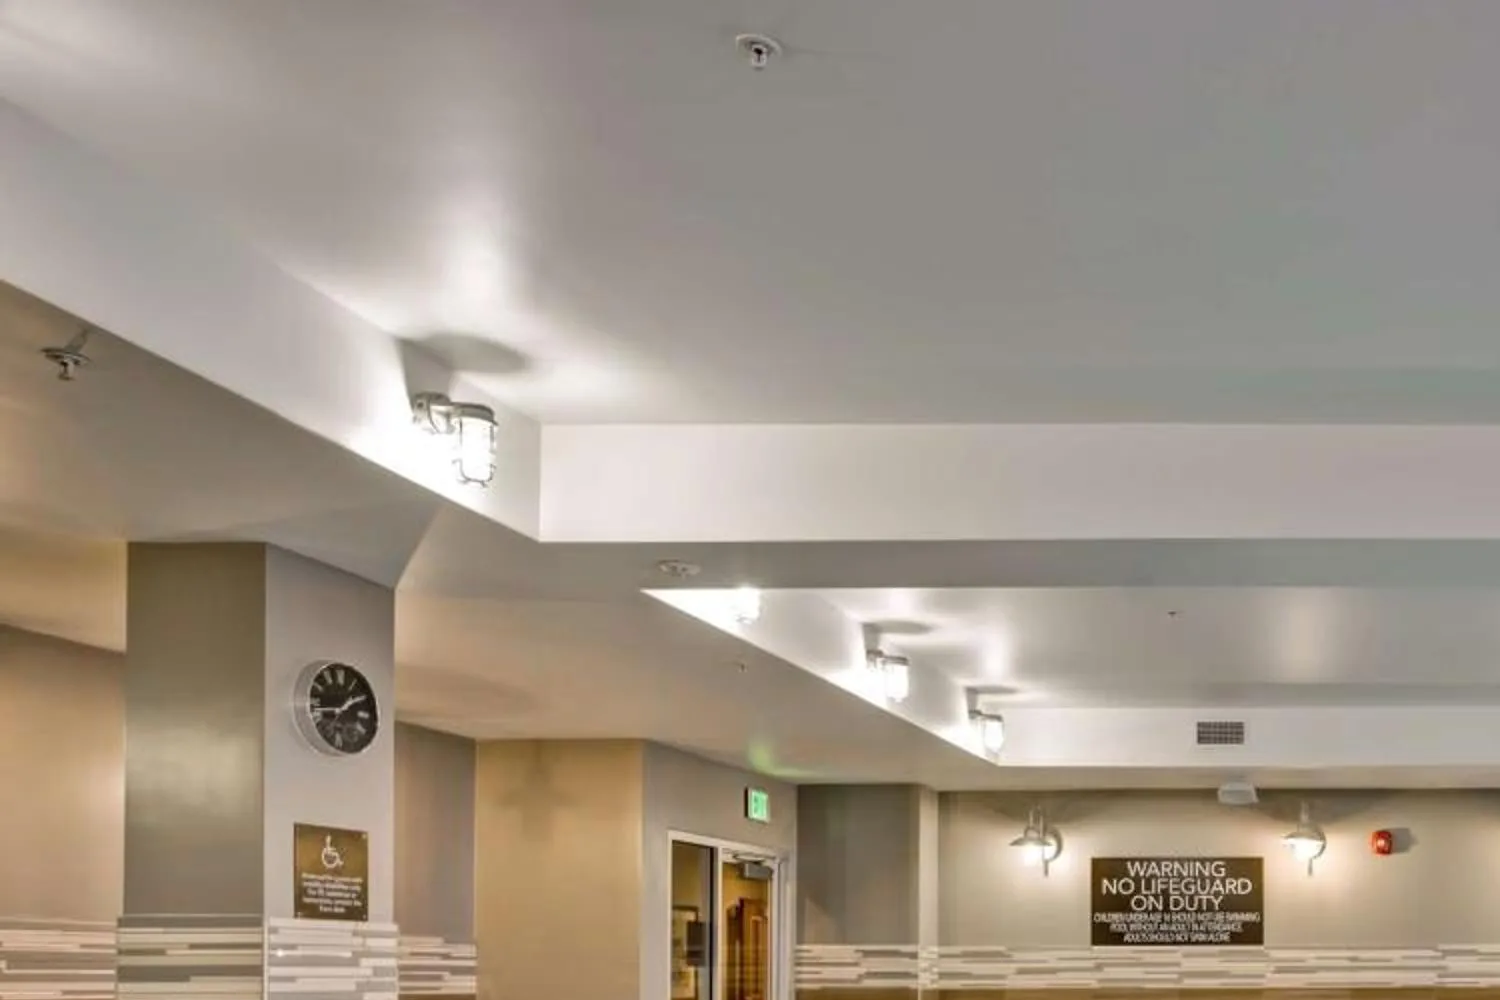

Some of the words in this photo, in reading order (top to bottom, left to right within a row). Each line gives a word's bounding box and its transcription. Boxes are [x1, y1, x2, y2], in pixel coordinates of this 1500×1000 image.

[1127, 861, 1226, 878] WARNING
[1102, 877, 1135, 895] NO
[1141, 878, 1252, 895] LIFEGUARD
[1130, 896, 1163, 911] ON
[1169, 896, 1224, 911] DUTY
